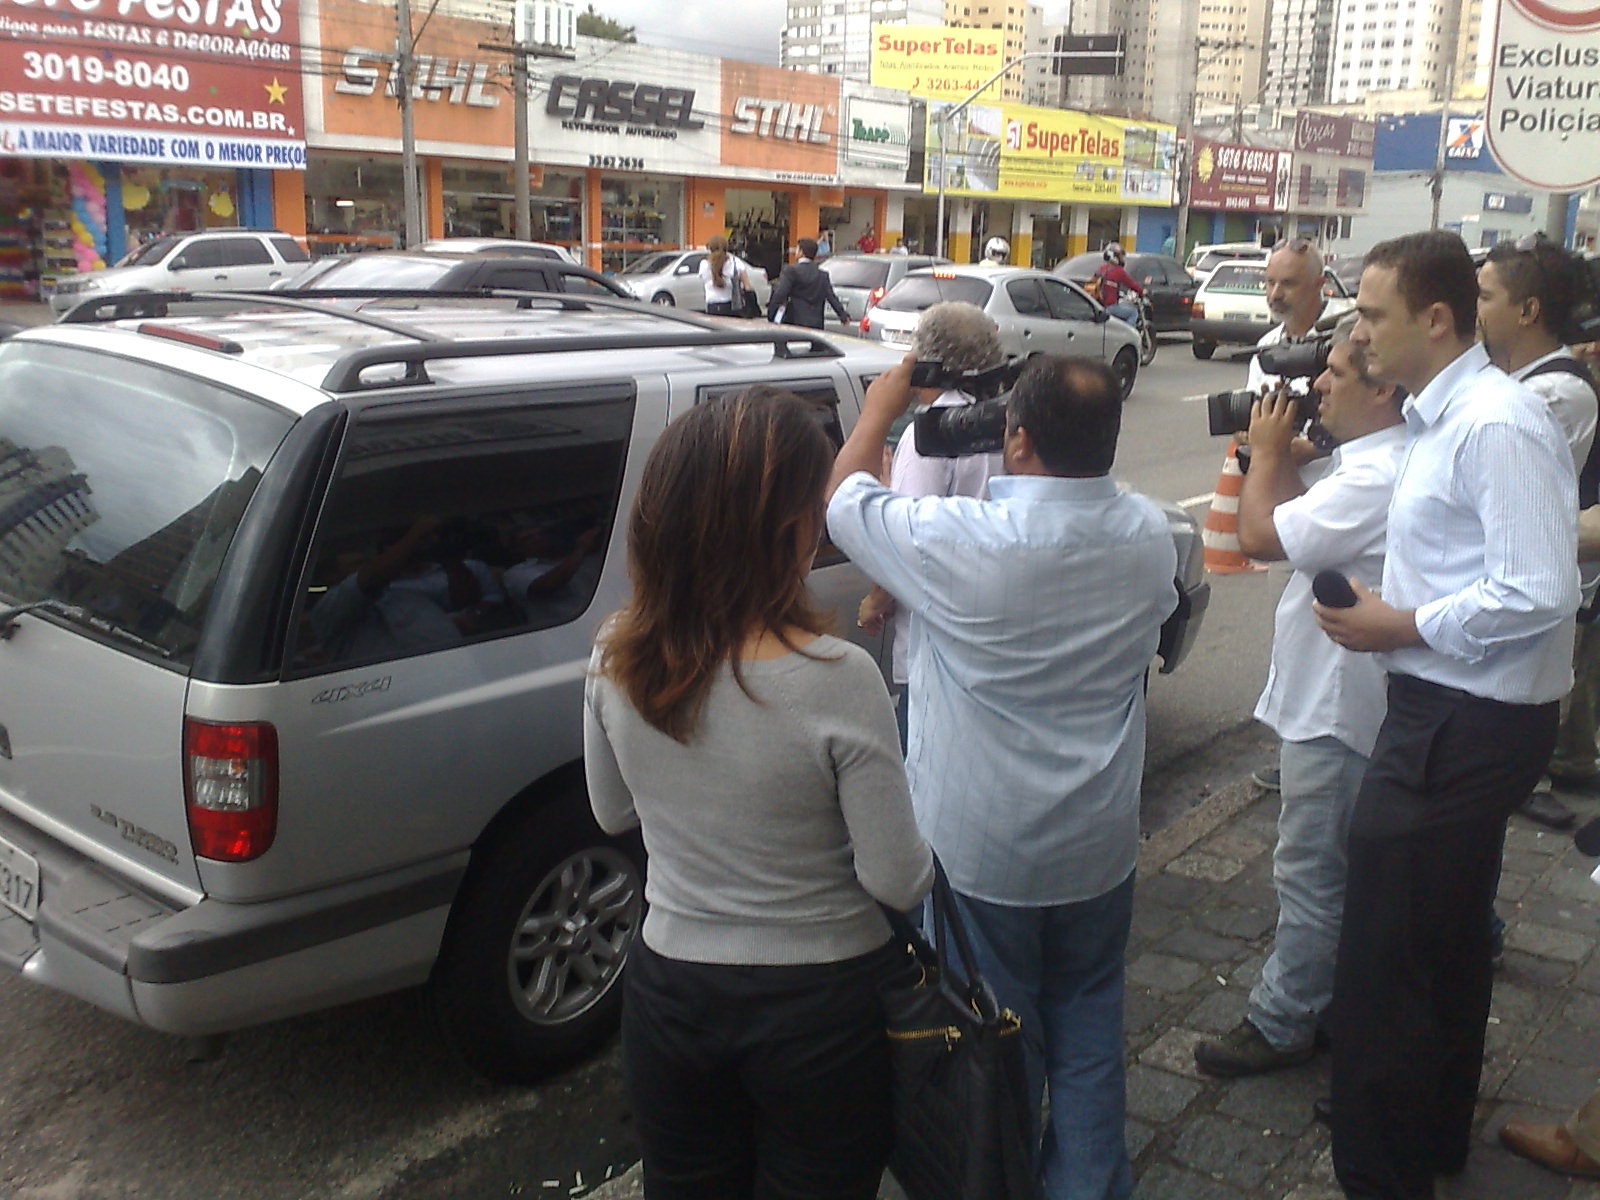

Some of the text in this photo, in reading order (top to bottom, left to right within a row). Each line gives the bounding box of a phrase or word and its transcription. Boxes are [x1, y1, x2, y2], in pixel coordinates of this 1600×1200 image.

[23, 51, 190, 92] 3019-8040
[1506, 75, 1600, 99] Viatur
[545, 75, 705, 130] CASSEL
[561, 120, 679, 140] REVENDEDOR AUTORIZADO
[731, 96, 832, 145] STIHL
[18, 130, 28, 149] A
[33, 131, 83, 152] MAIOR
[88, 134, 165, 157] VARIEDADE
[171, 139, 200, 159] COM
[205, 142, 215, 159] O
[219, 142, 263, 162] MENOR
[1026, 121, 1120, 158] SuperTelas
[1448, 147, 1480, 158] CAIXA
